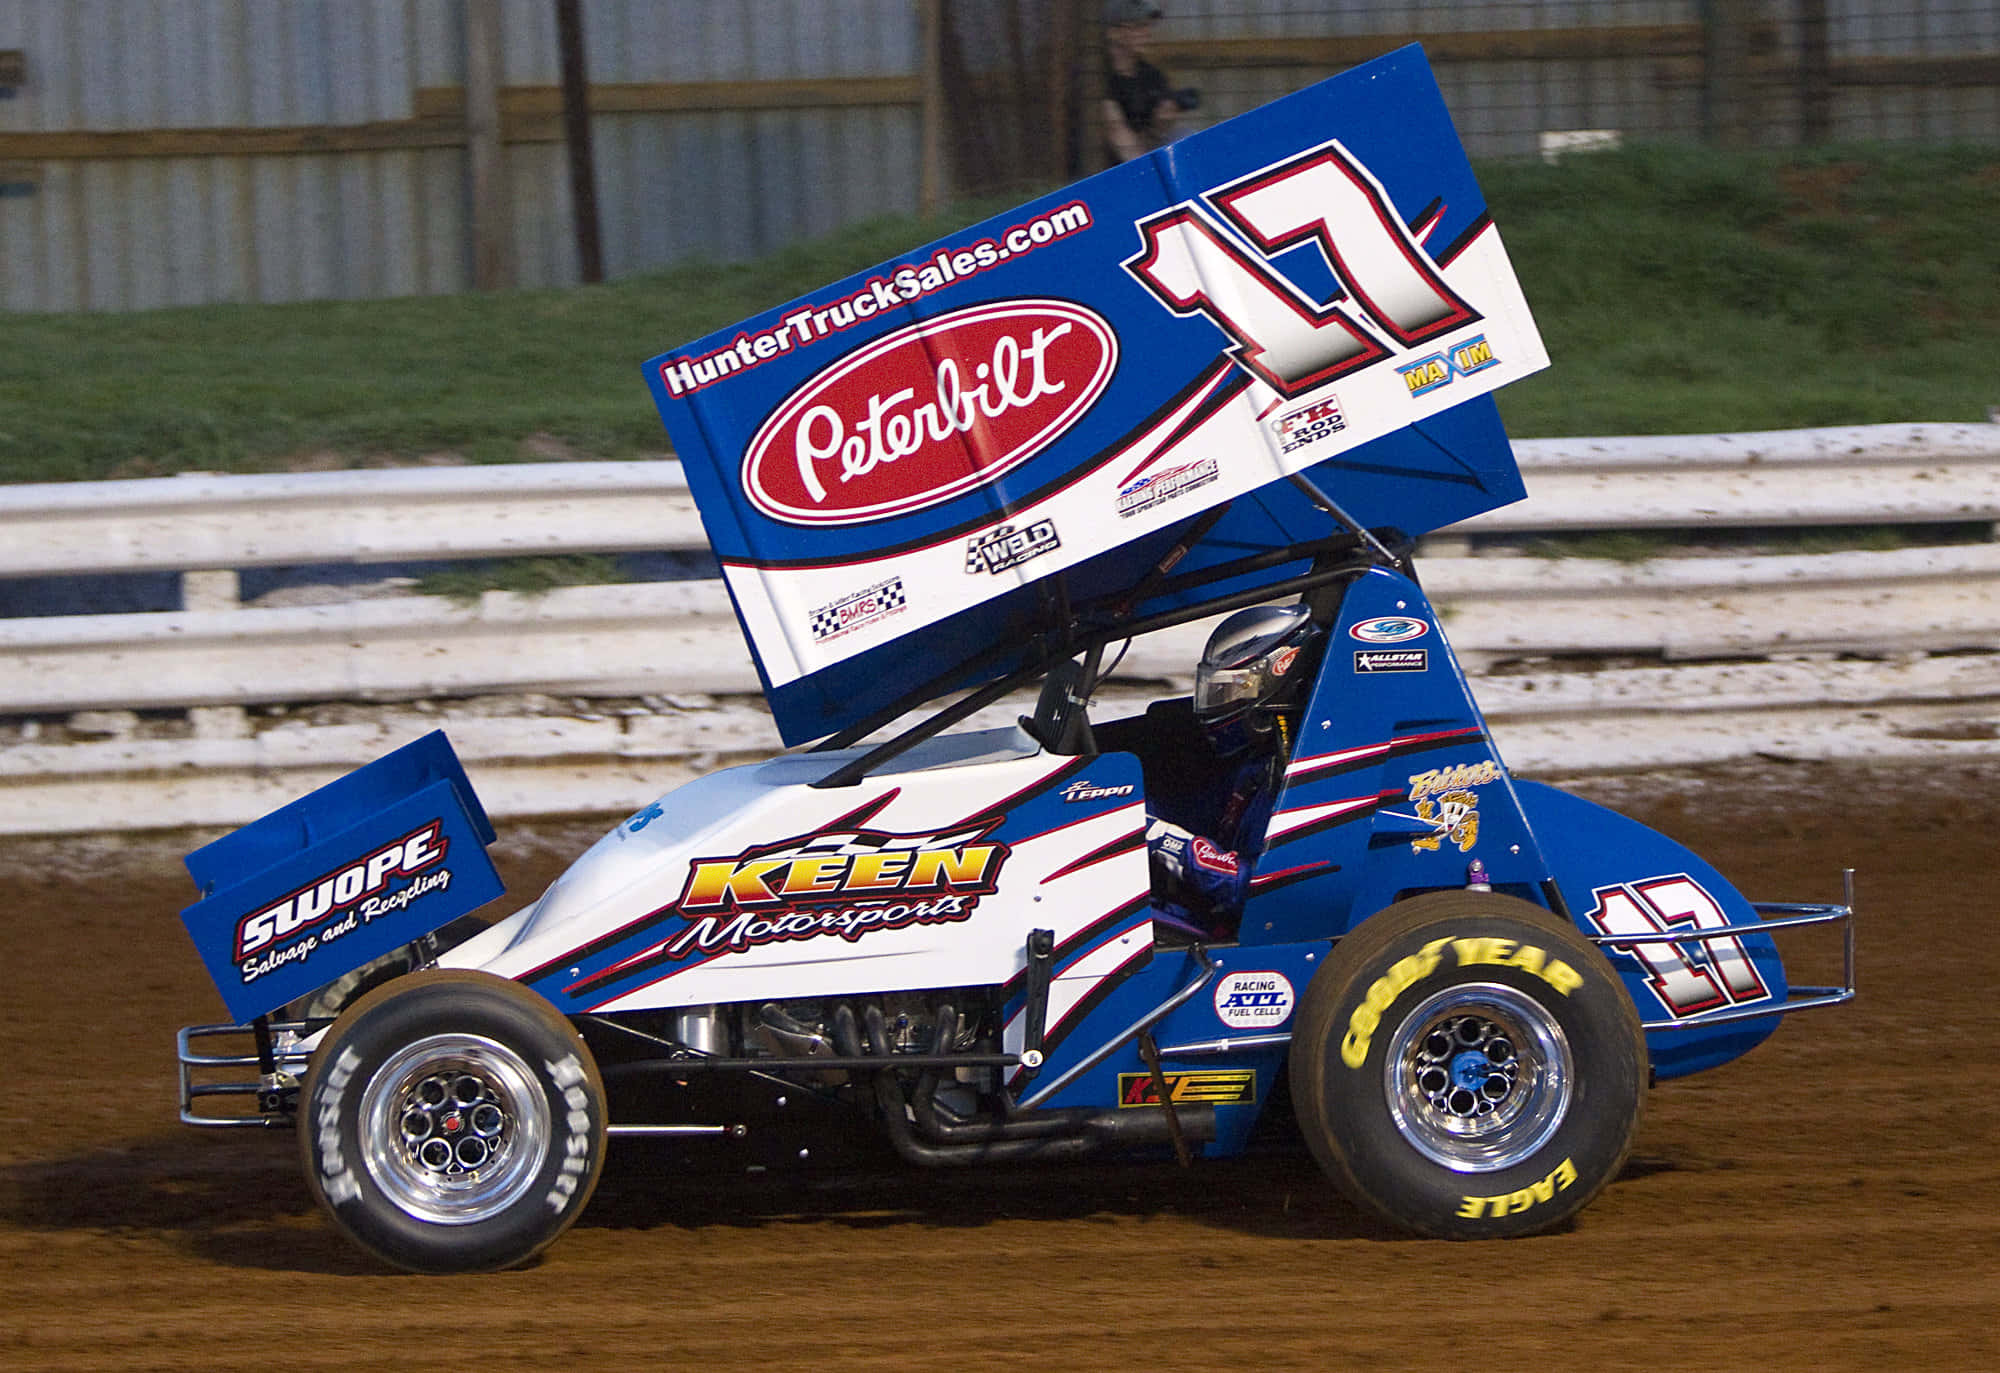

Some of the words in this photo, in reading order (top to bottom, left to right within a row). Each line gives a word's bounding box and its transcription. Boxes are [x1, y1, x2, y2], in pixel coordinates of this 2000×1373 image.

[1118, 138, 1485, 401] 17
[662, 202, 1091, 396] HunterTruckSales.com
[1399, 337, 1498, 393] MAXIM
[795, 322, 1073, 503] Peterbilt
[1281, 421, 1346, 455] ENDS
[1292, 414, 1343, 440] ROD
[982, 522, 1055, 564] WELD
[992, 539, 1058, 572] RACING
[839, 598, 877, 625] BMRS
[1370, 653, 1424, 662] ALLSTAR
[241, 828, 442, 954] SWOPE
[681, 845, 998, 909] KEEN
[242, 936, 318, 983] Salvage
[322, 911, 358, 942] and
[360, 870, 451, 922] Recycling
[669, 895, 970, 953] Motorsports
[1584, 872, 1773, 1020] 17
[1228, 1008, 1251, 1017] FUEL
[1253, 1007, 1282, 1016] CELLS
[1233, 981, 1276, 991] RACING
[1455, 1156, 1579, 1219] EAGLE
